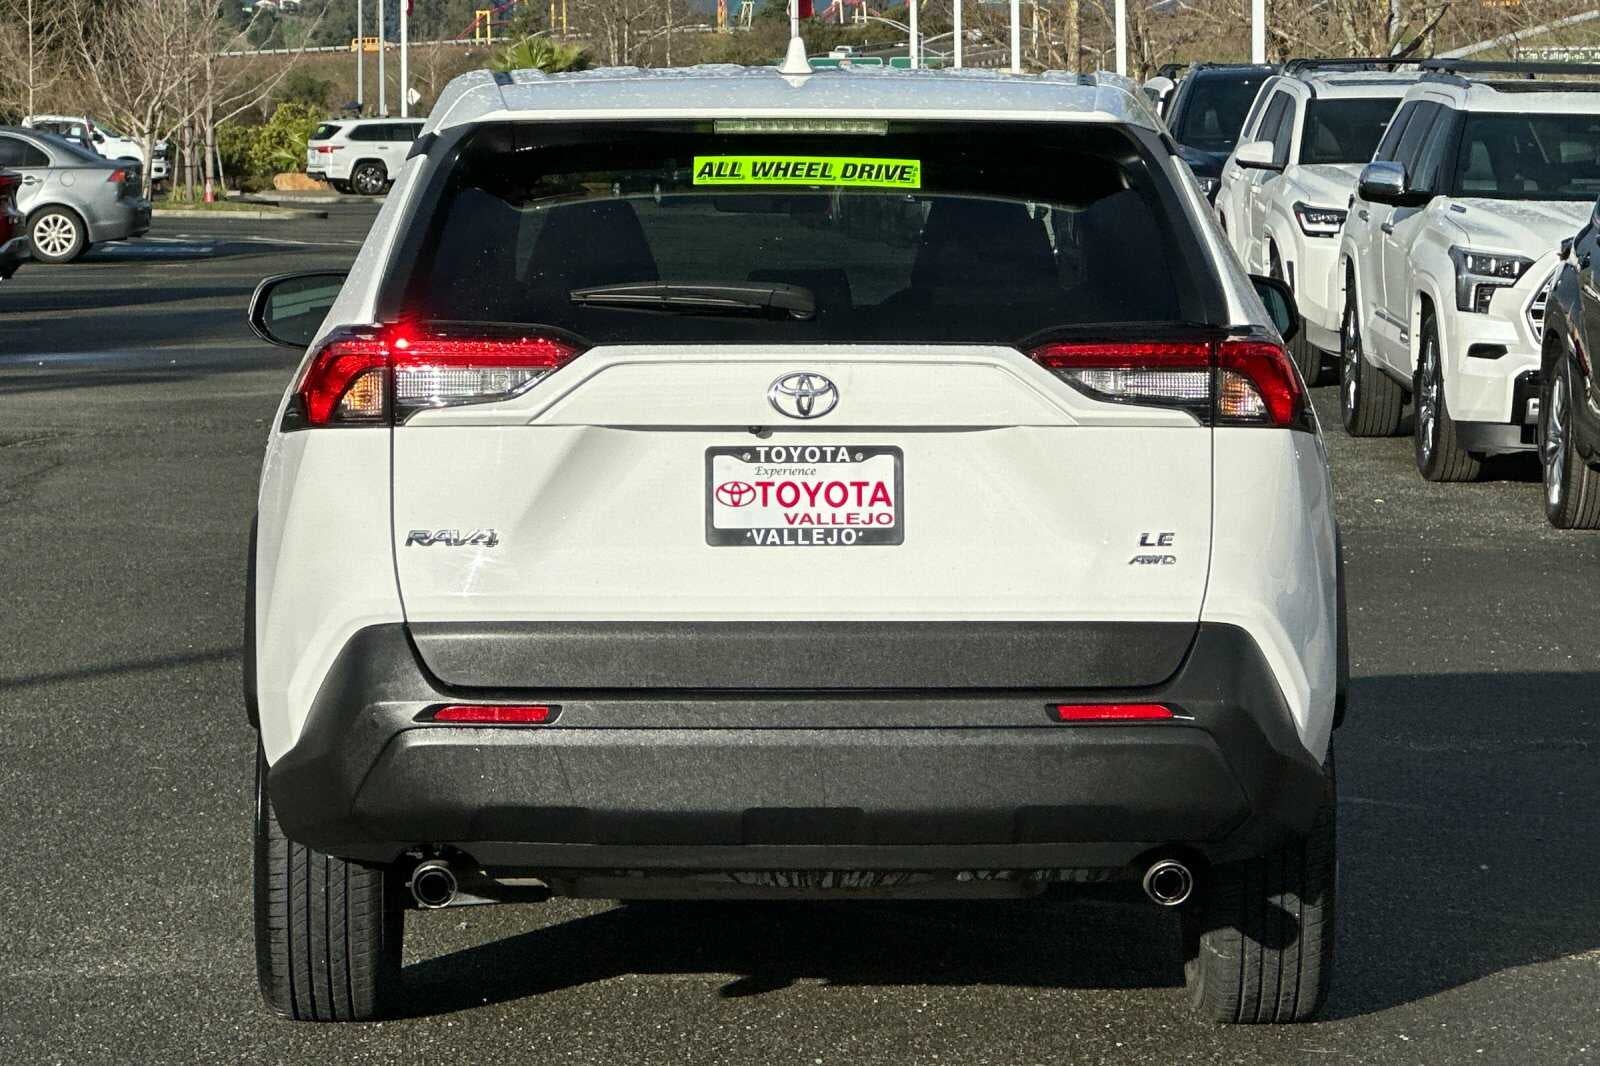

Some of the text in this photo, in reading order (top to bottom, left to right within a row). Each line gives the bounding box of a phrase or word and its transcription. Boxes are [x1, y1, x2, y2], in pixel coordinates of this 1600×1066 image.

[696, 161, 917, 183] ALL WHEEL DRIVE
[755, 447, 850, 463] TOYOTA
[754, 465, 816, 479] Experience
[755, 481, 893, 508] TOYOTA
[784, 512, 893, 526] VALLEJO
[404, 529, 499, 547] RAV4
[751, 528, 857, 545] VALLEJO
[1139, 532, 1175, 547] LE
[1127, 554, 1177, 565] AWD
